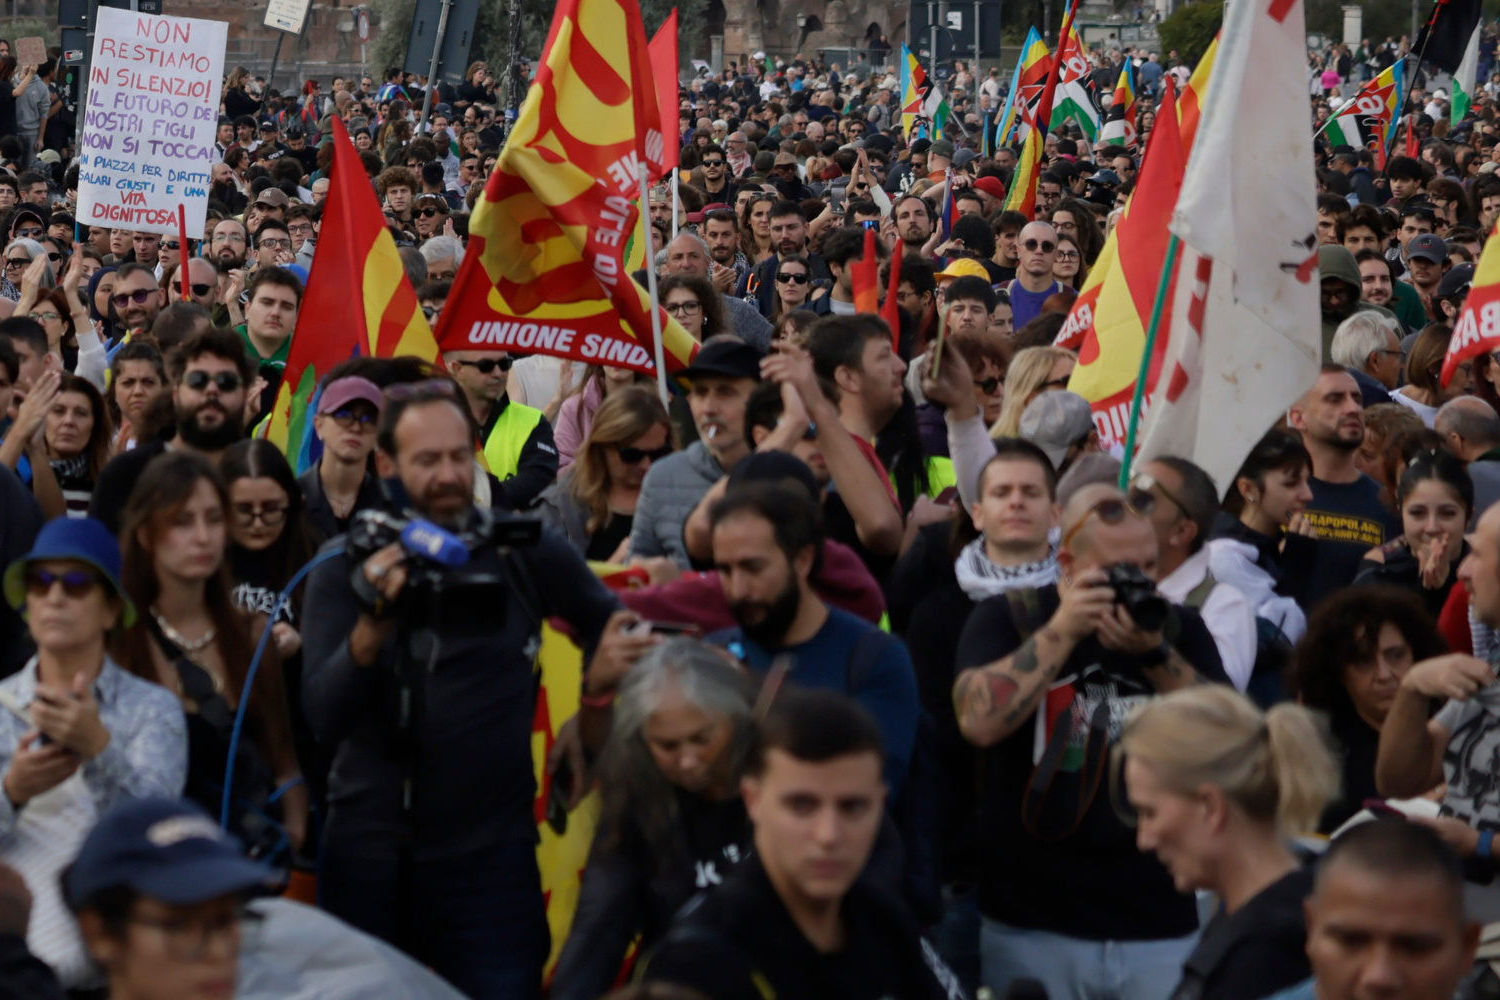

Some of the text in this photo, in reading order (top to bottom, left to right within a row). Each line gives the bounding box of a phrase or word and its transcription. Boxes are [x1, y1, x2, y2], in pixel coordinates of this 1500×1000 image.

[136, 17, 191, 44] NON
[100, 38, 211, 73] RESTIAMO
[91, 66, 212, 104] IN SILENZIO!
[89, 88, 104, 108] IL
[113, 91, 189, 119] FUTURO
[84, 110, 196, 140] NOSTRI FIGLI
[82, 131, 215, 164] NON SI TOCCA!
[80, 152, 89, 166] IN
[93, 155, 136, 174] PIAZZA
[141, 164, 163, 177] PER
[78, 169, 207, 198] SALARI GIUSTI E UNA
[120, 190, 148, 207] VITA
[91, 202, 178, 228] DIGNITOSA
[468, 320, 655, 369] UNIONE SIND
